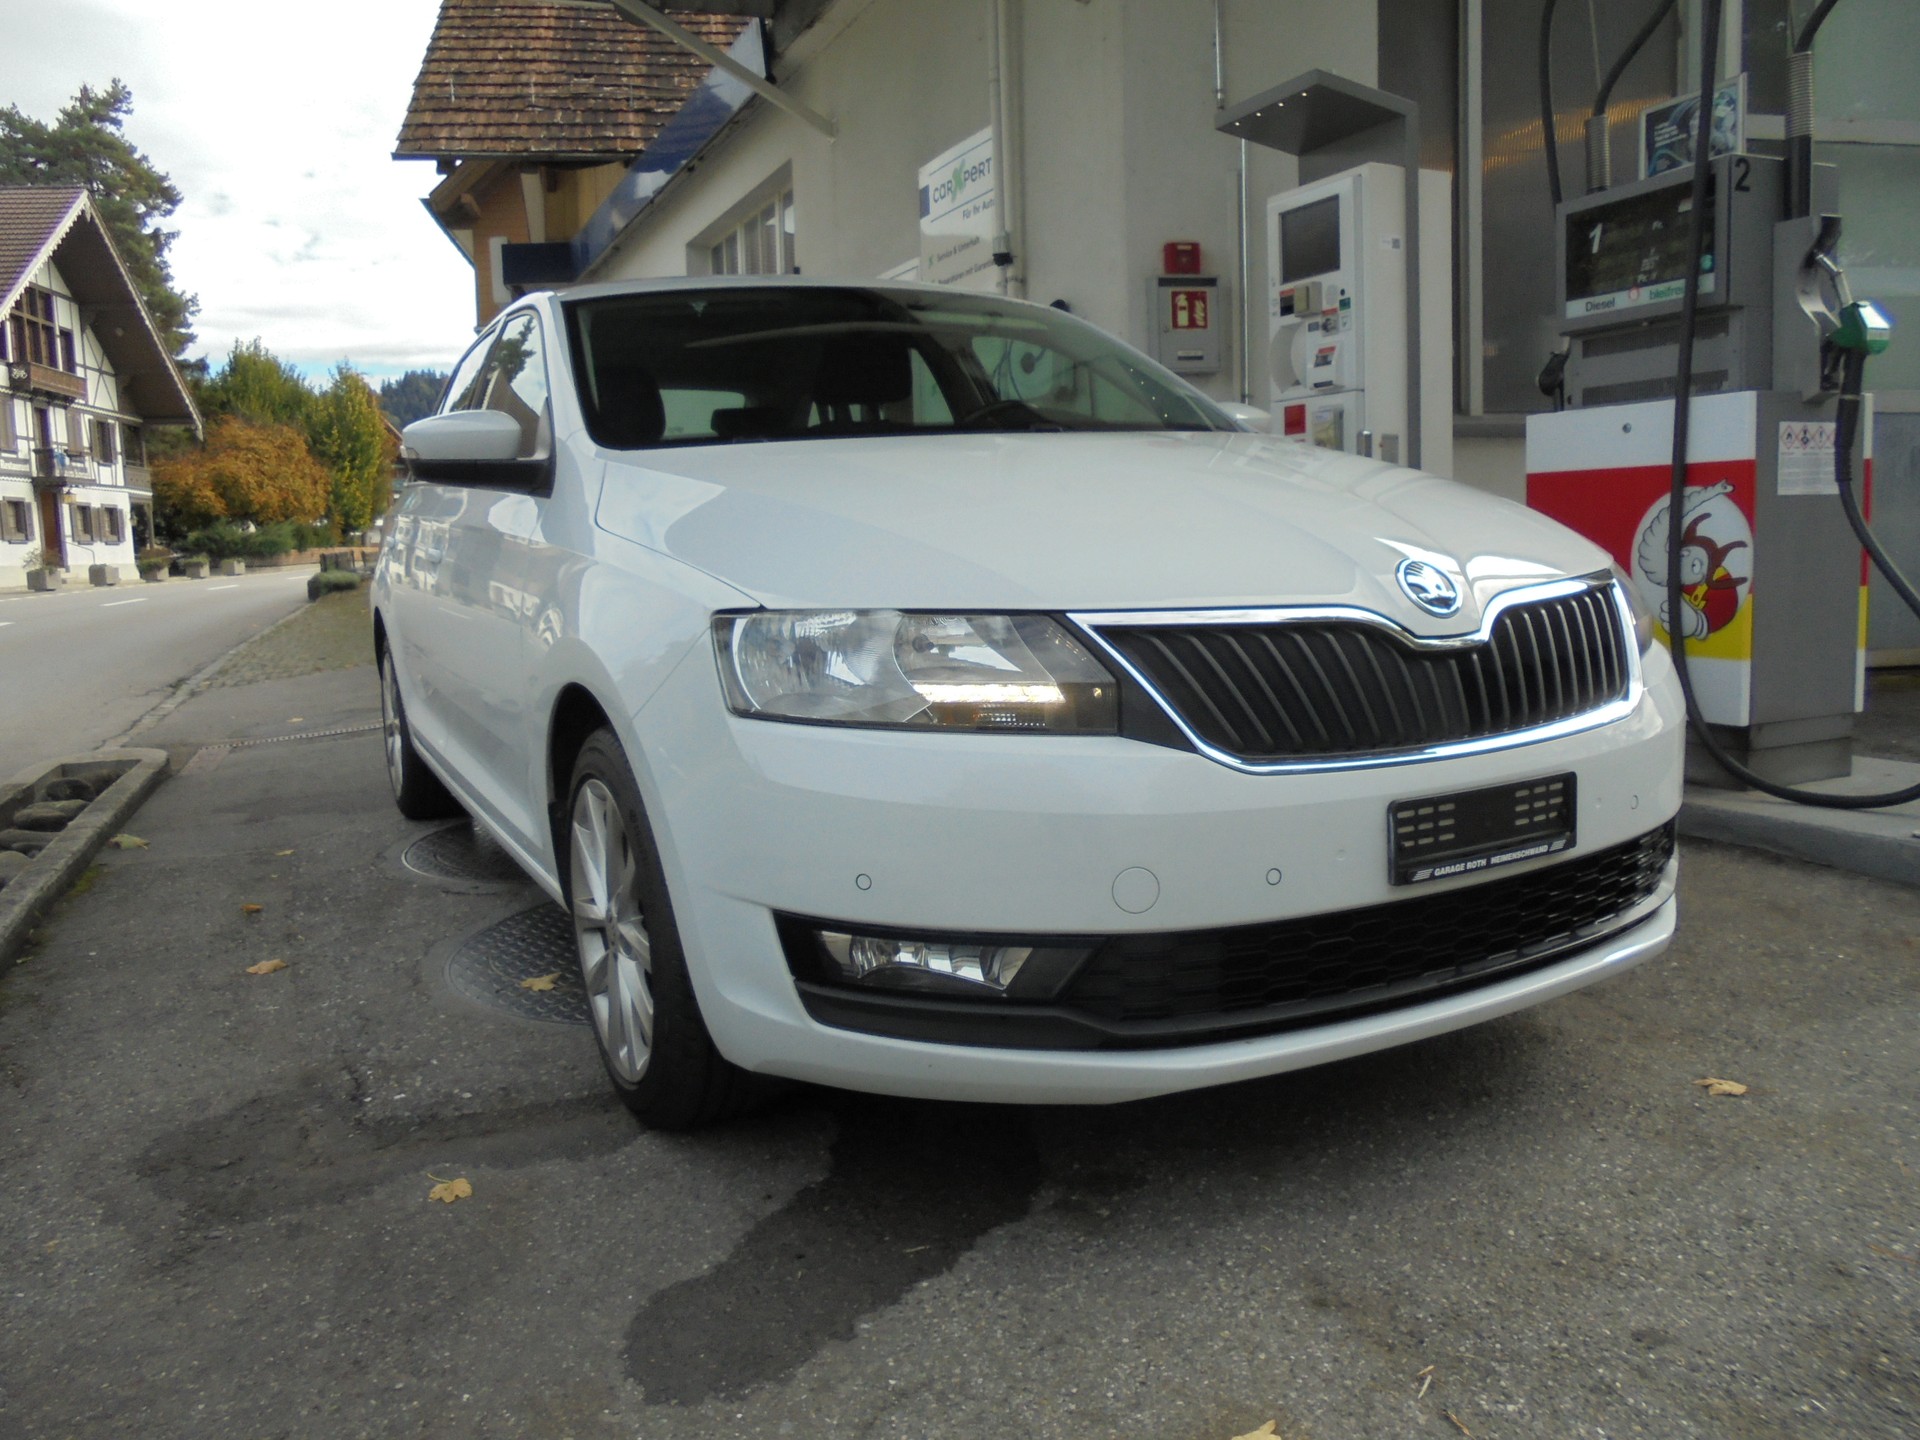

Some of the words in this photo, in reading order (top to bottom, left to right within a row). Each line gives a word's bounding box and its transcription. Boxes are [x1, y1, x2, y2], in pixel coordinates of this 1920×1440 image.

[1735, 158, 1751, 192] 2
[1589, 222, 1603, 254] 1
[1585, 297, 1615, 312] Diesel
[1434, 862, 1465, 877] GARAGE
[1466, 858, 1487, 870] ROTH
